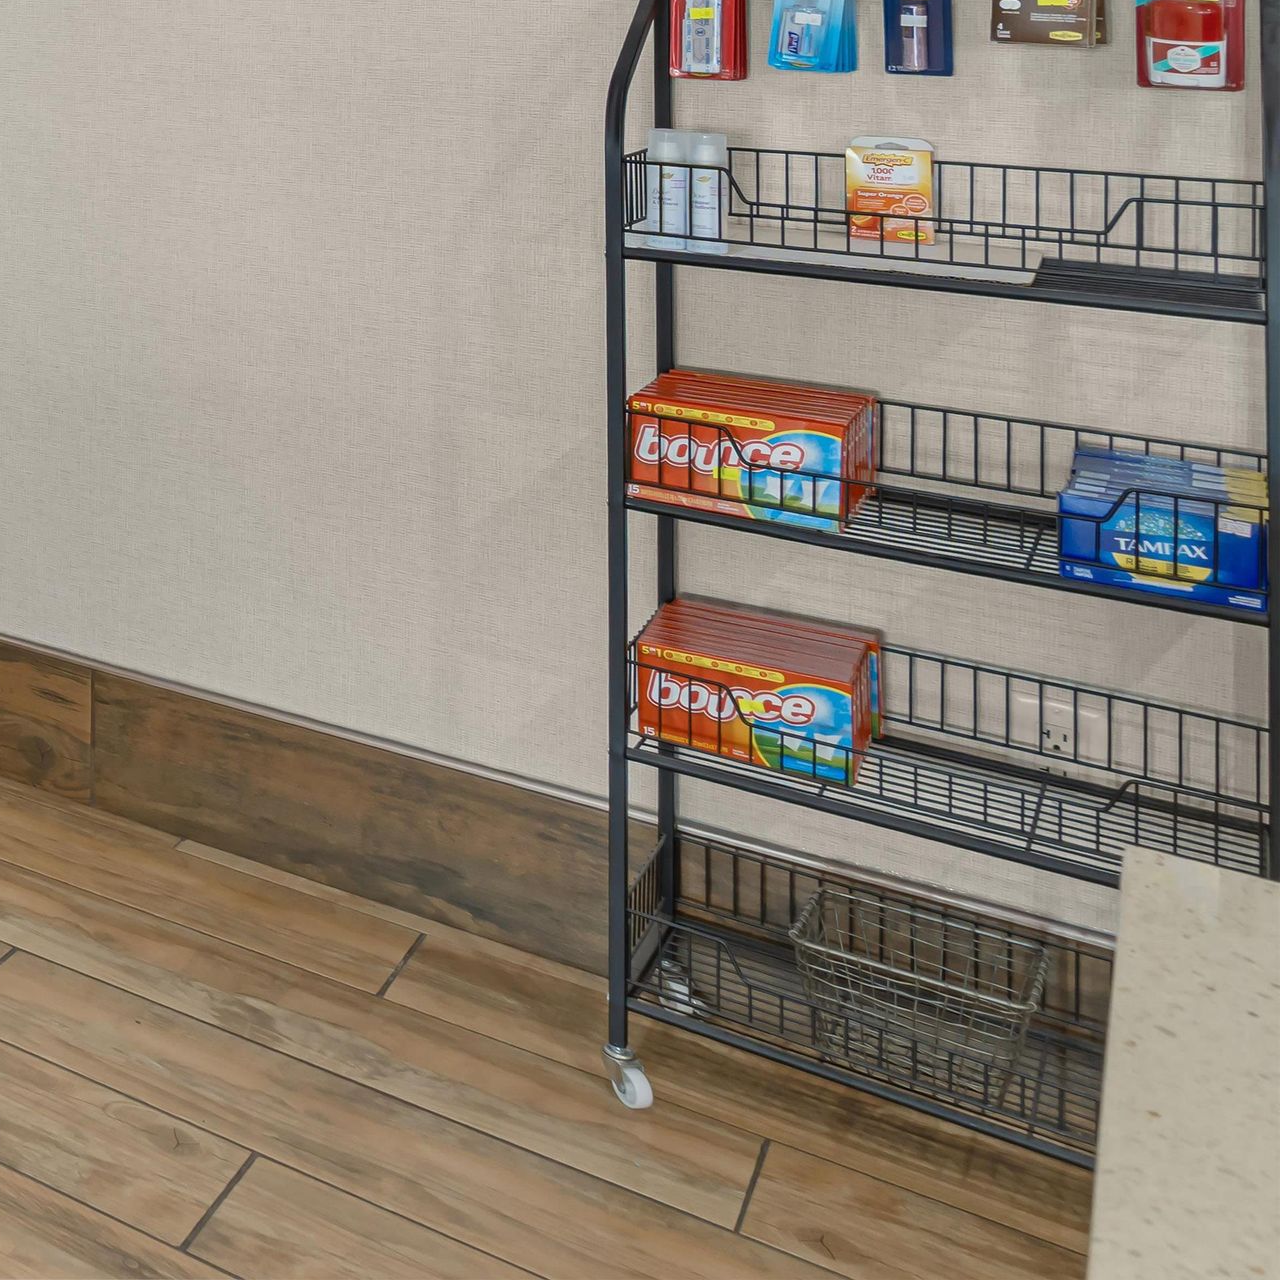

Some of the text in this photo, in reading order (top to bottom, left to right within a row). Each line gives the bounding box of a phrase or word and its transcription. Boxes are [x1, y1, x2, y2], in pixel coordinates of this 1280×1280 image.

[866, 155, 912, 164] Emergen-C
[632, 401, 652, 412] 5 1
[636, 425, 804, 471] bounce
[628, 484, 640, 494] 15
[1114, 537, 1208, 560] TAMPAX
[642, 645, 662, 657] 5 1
[643, 726, 655, 736] 15
